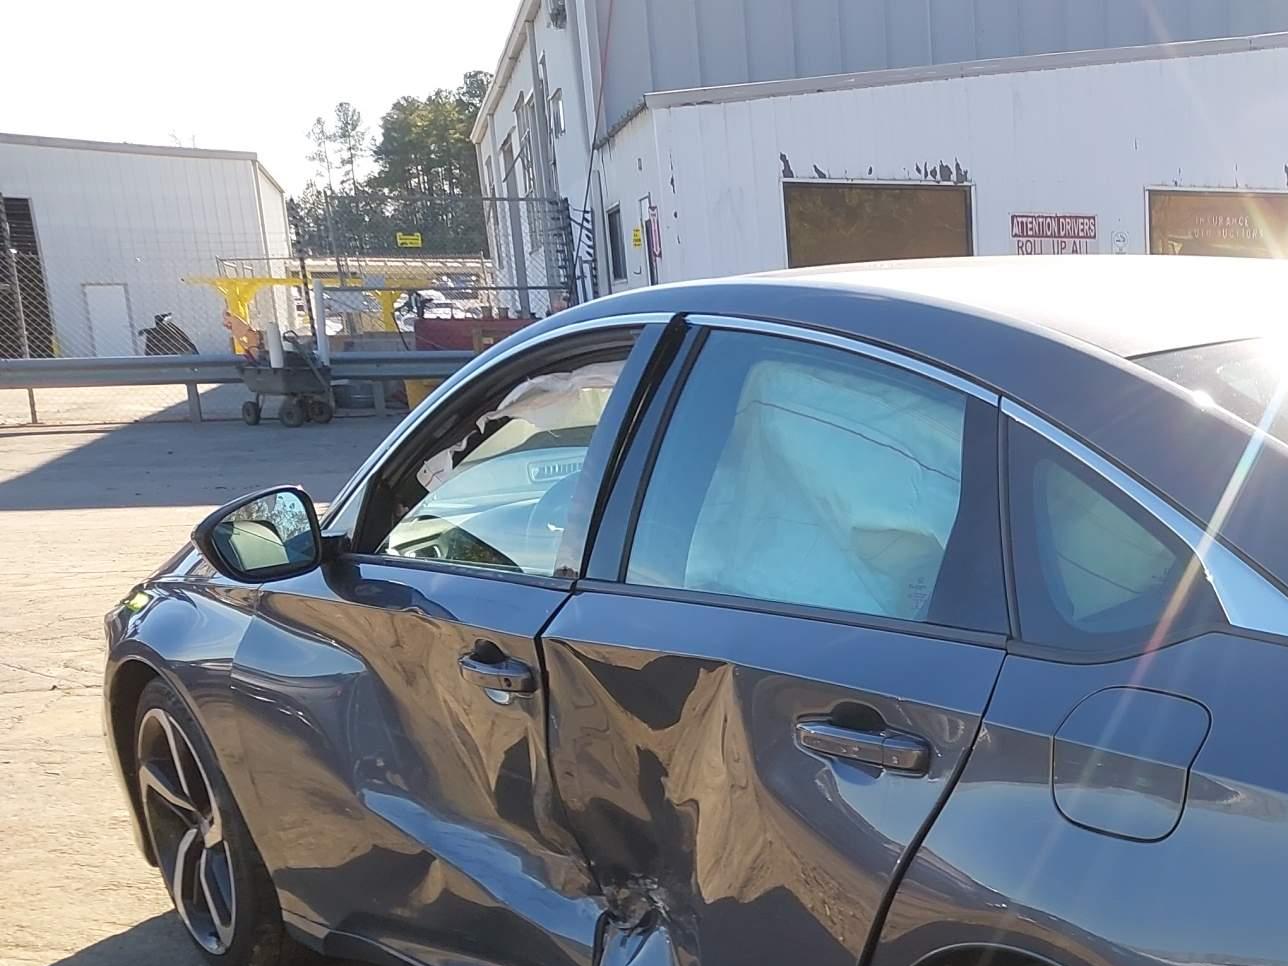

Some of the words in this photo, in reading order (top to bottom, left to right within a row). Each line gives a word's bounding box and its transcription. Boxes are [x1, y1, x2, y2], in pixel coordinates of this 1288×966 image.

[1012, 217, 1058, 236] ATTENTION
[1060, 218, 1096, 237] DRIVERS
[1052, 240, 1067, 256] UP
